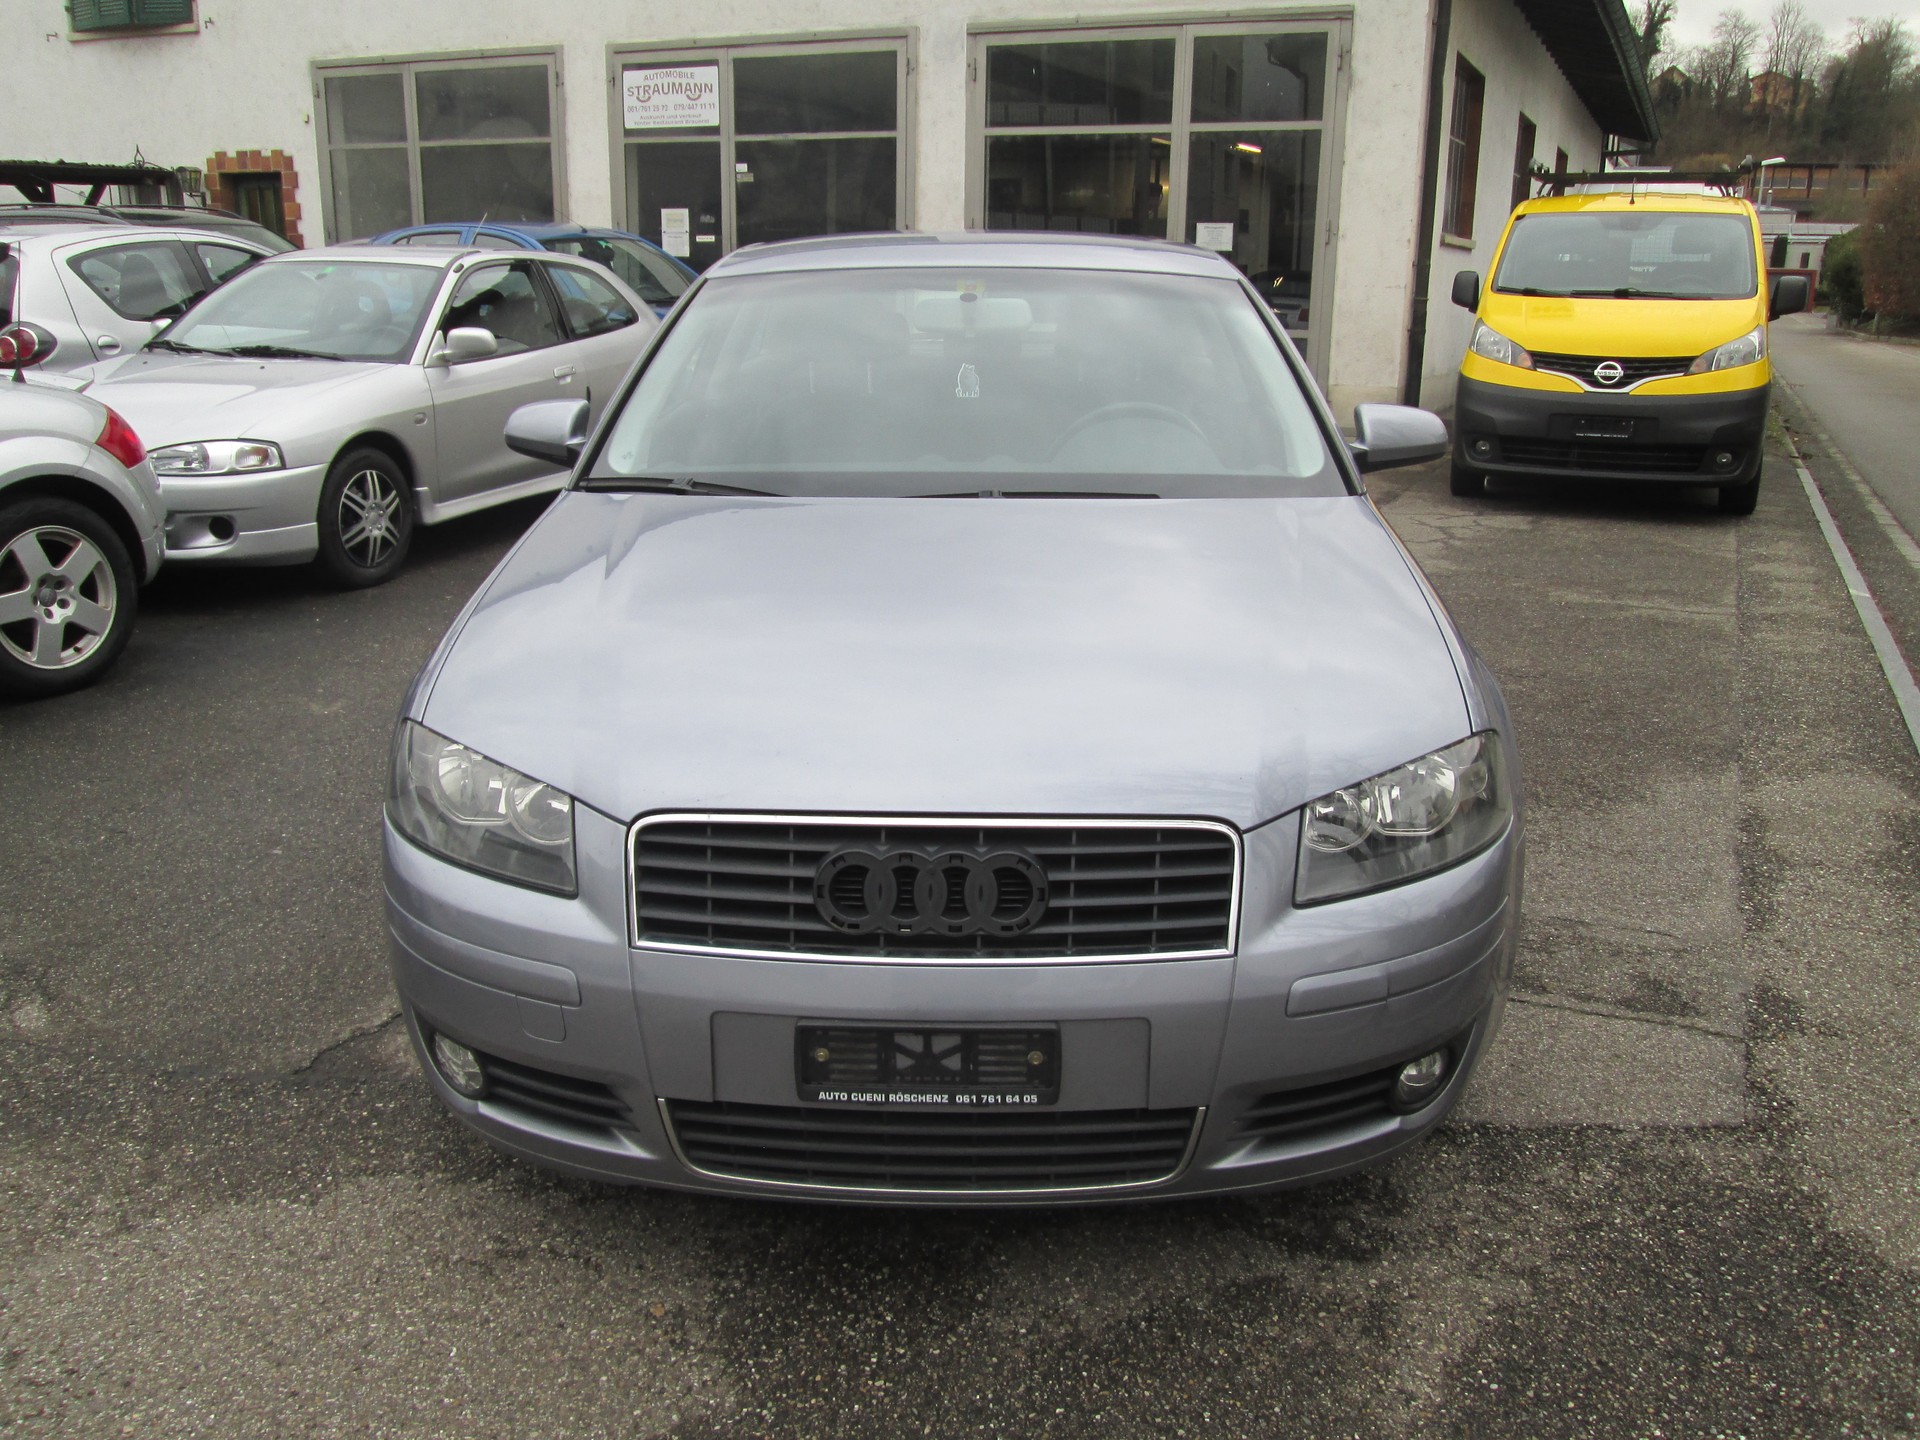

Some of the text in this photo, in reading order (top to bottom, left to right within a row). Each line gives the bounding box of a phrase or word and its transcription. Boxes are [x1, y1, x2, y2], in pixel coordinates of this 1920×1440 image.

[643, 70, 695, 81] AUTOMOBILE
[627, 82, 713, 97] STRAUMANN
[818, 1091, 1038, 1104] AUTO CUENI RÖSCHENZ 061 761 64 05
